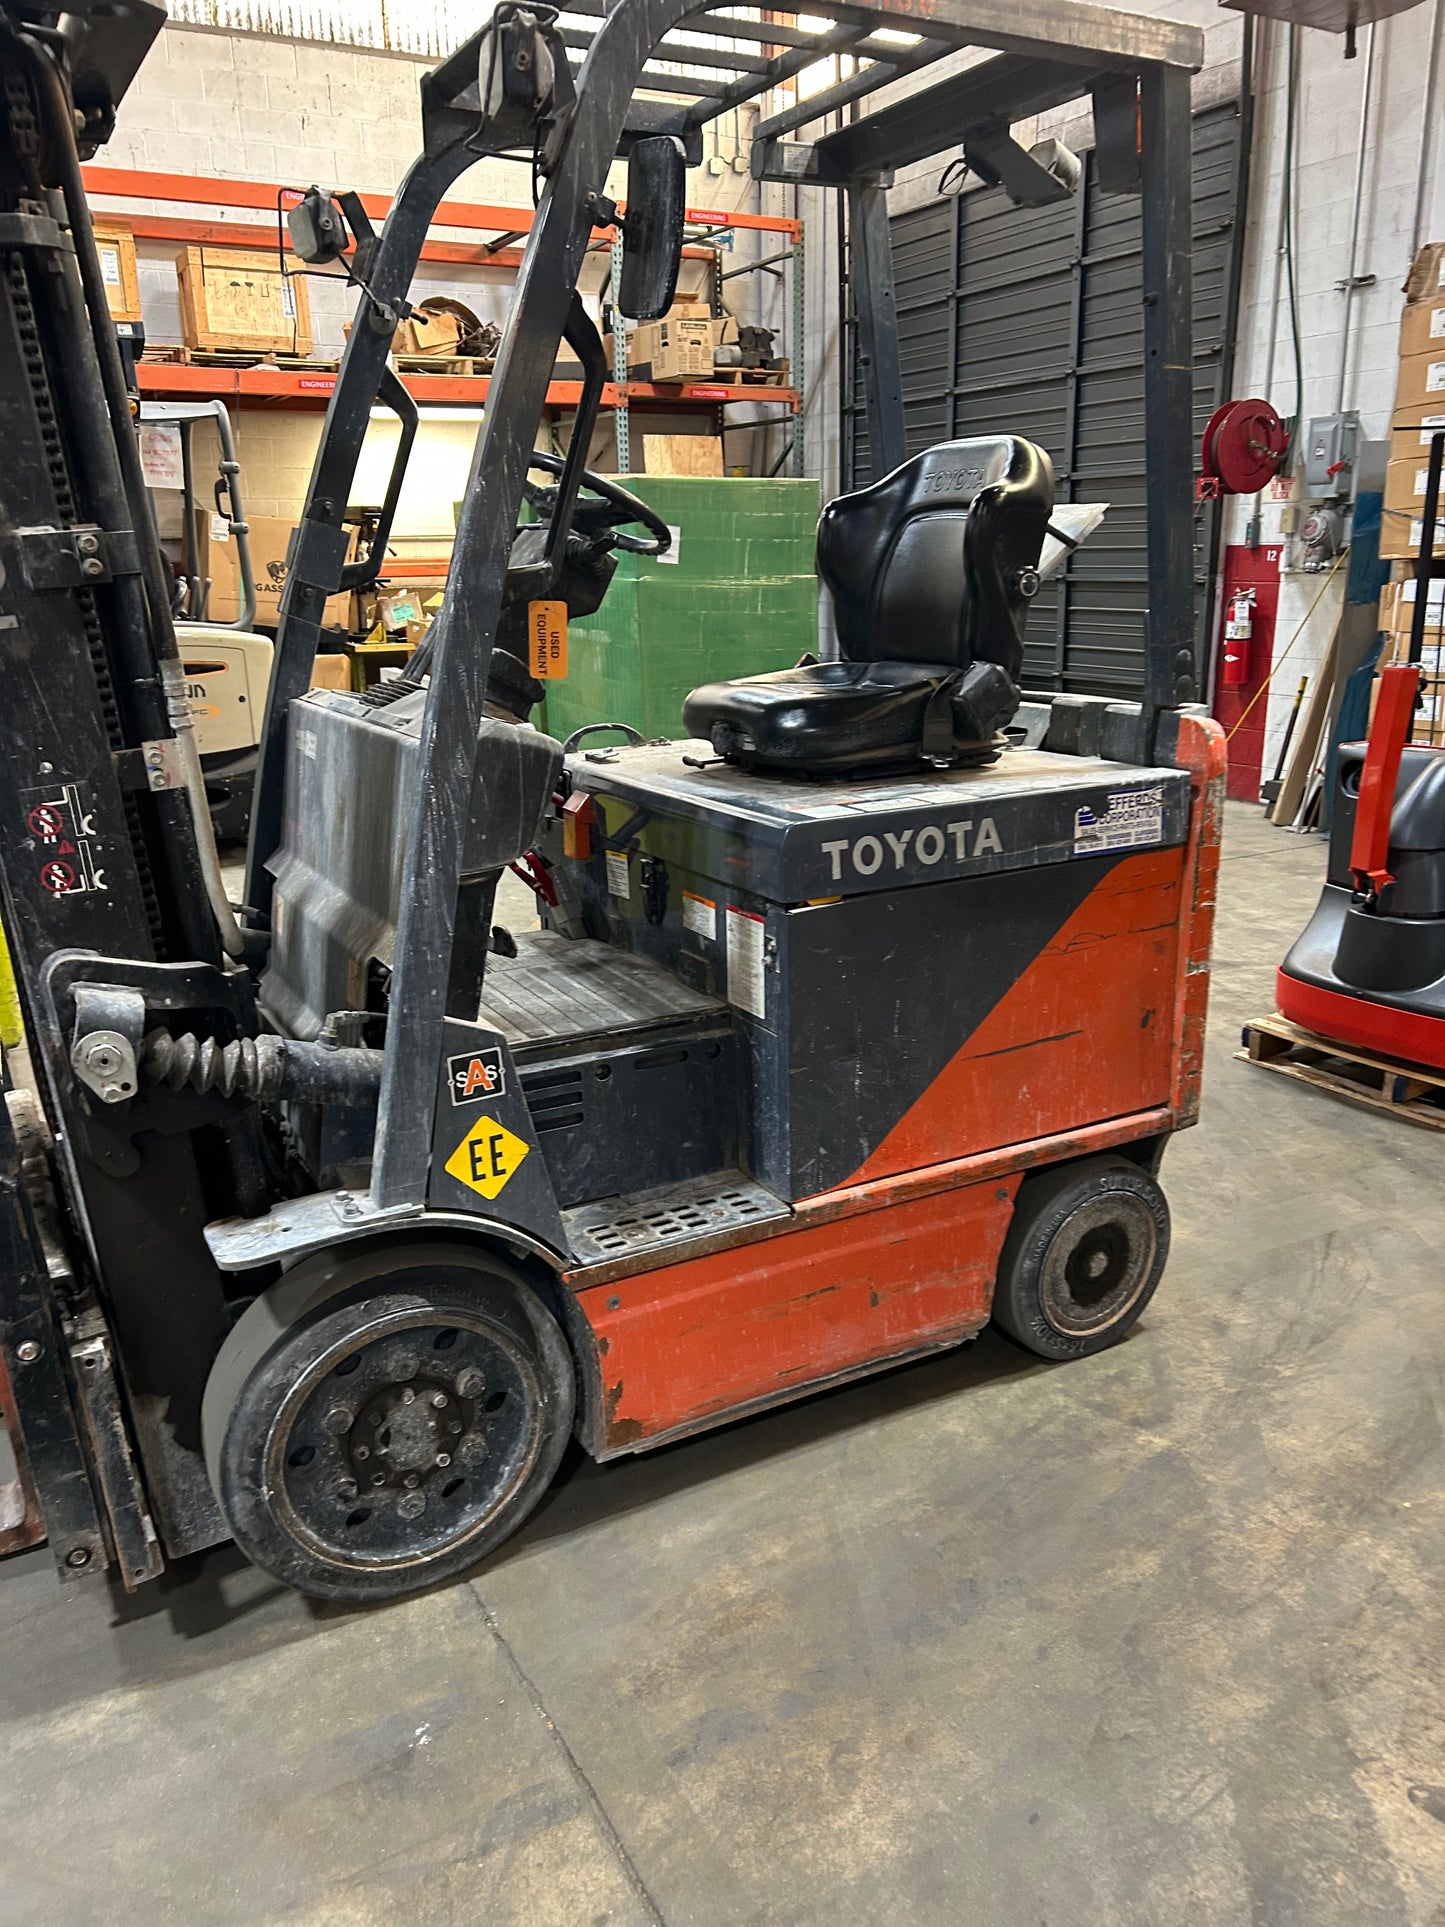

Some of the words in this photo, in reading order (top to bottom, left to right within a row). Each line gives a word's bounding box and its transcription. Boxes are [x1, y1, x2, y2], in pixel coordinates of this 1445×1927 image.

[924, 467, 987, 494] TOYOTA
[1267, 550, 1277, 561] 12
[537, 613, 547, 676] EQUIPMENT
[550, 631, 560, 659] USED
[821, 817, 1004, 880] TOYOTA
[468, 1134, 507, 1182] EE
